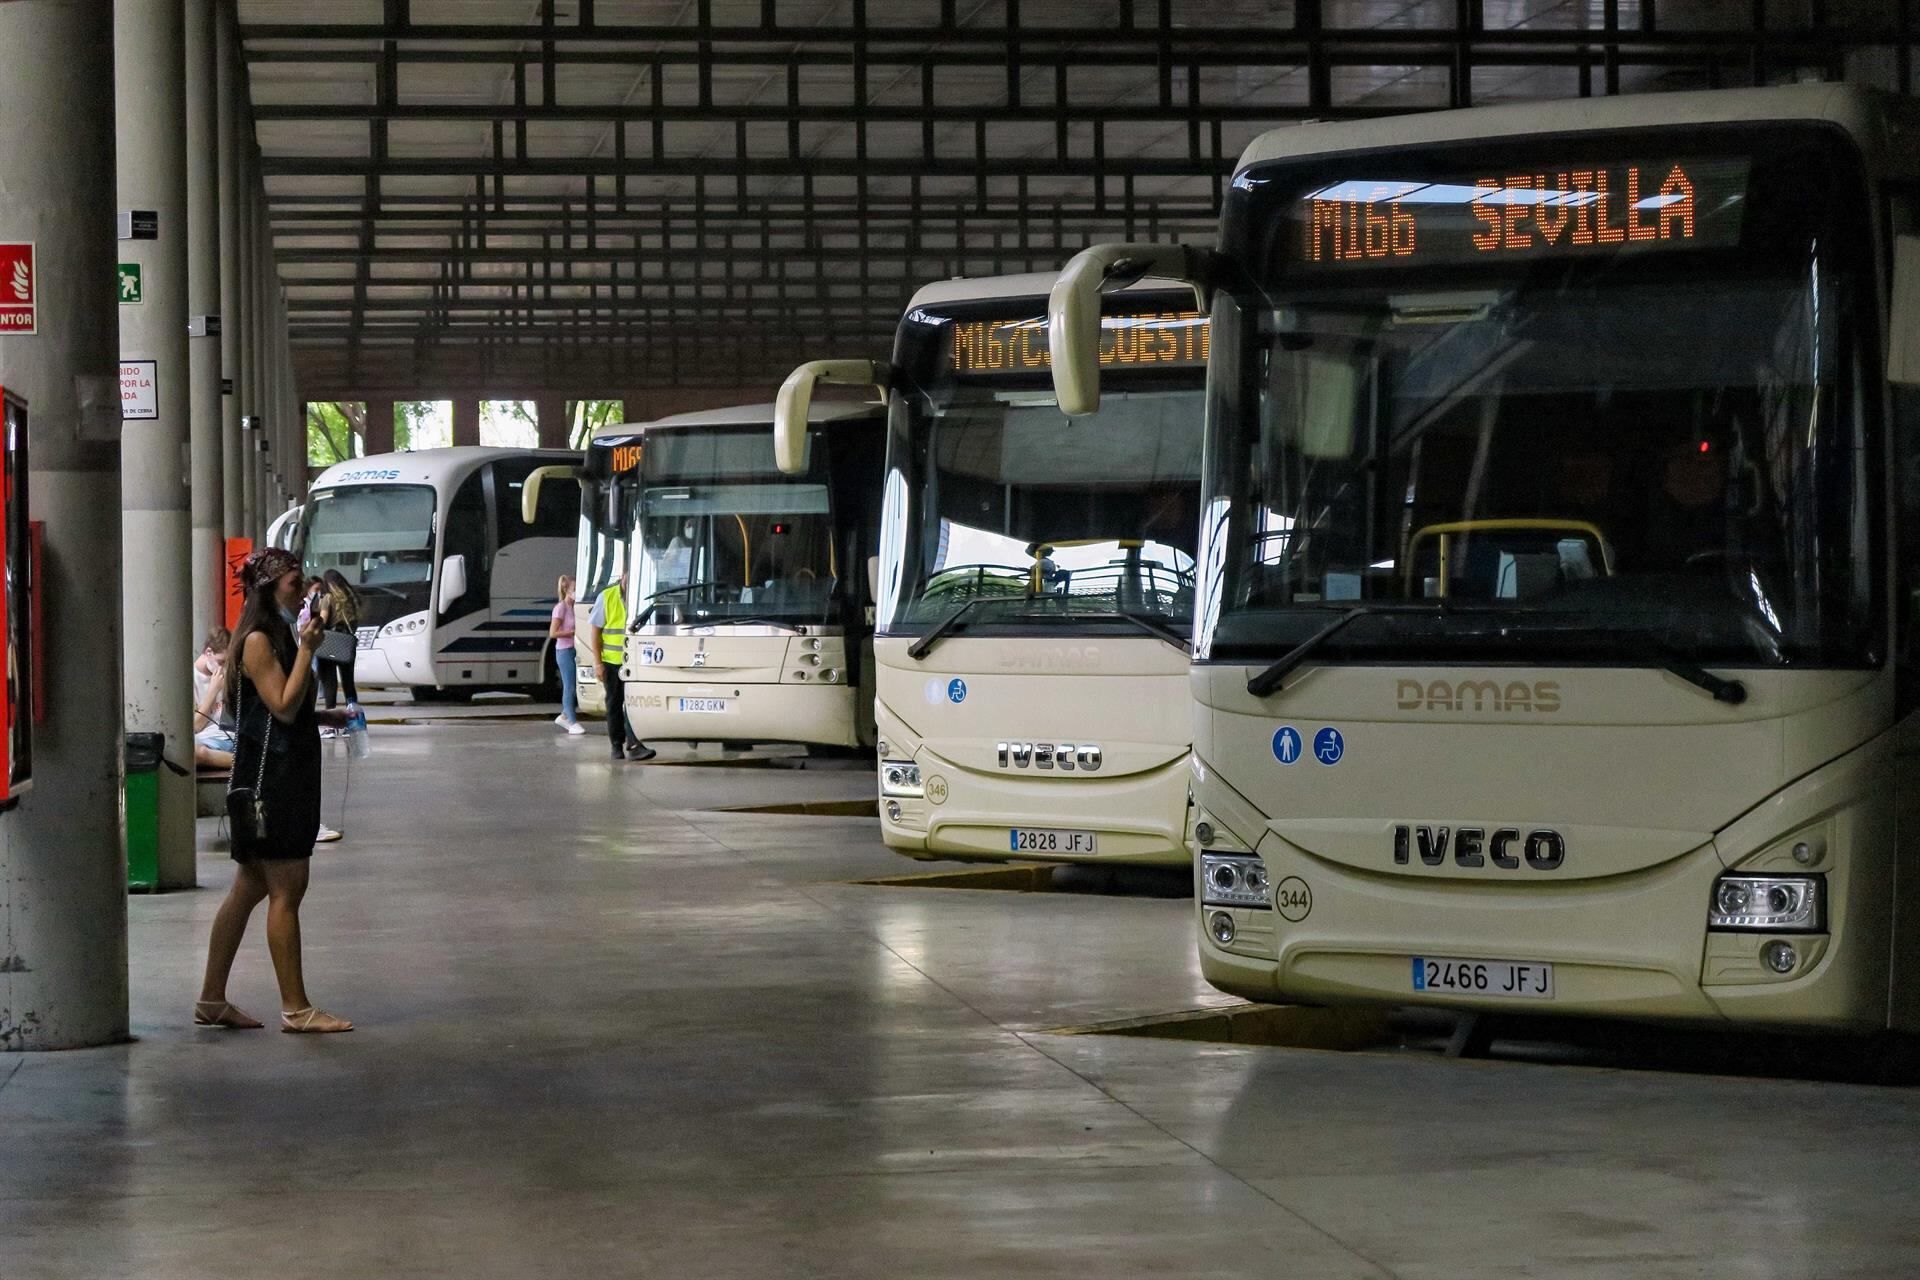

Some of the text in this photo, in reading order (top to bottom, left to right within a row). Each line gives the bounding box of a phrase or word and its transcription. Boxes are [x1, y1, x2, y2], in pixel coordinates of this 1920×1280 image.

[1313, 165, 1693, 260] M166 SEVILLA
[140, 380, 151, 388] LA
[338, 470, 400, 482] DAMAS
[686, 699, 705, 711] 1282
[1396, 679, 1561, 712] DAMAS
[997, 742, 1103, 772] IVECO
[929, 783, 946, 797] 346
[1019, 832, 1093, 852] 2828 JFJ
[1393, 825, 1565, 871] IVECO
[1280, 890, 1309, 909] 344
[1426, 962, 1549, 993] 2466 JFJ
